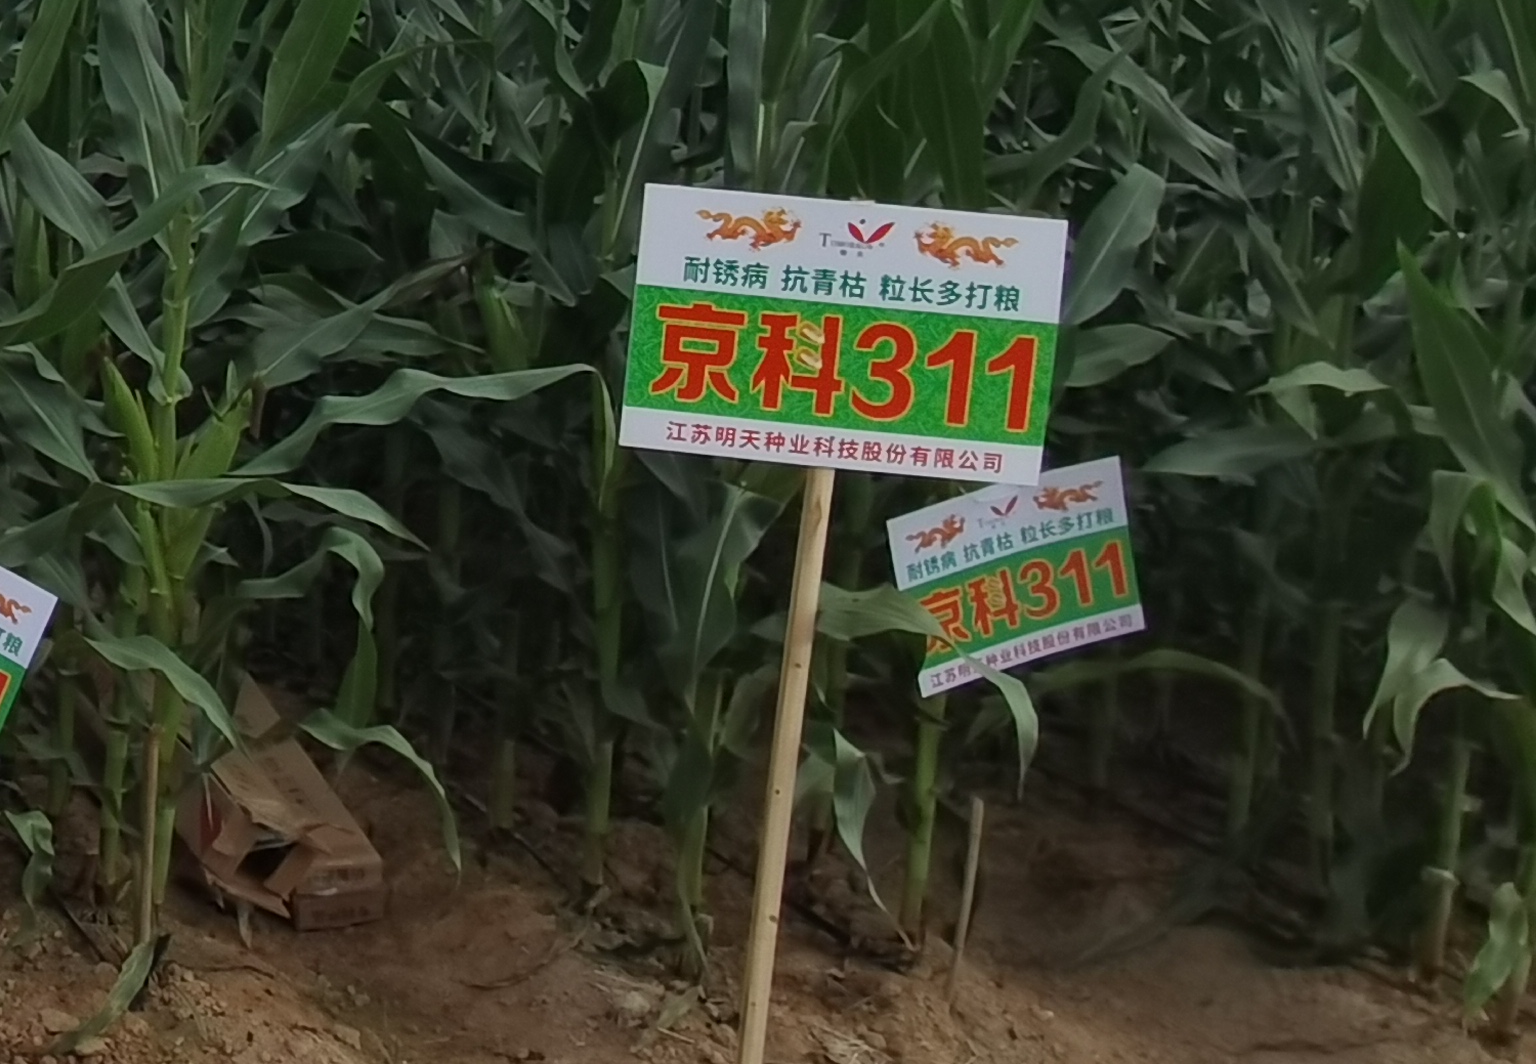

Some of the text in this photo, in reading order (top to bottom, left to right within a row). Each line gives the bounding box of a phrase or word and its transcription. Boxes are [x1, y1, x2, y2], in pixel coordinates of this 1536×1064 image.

[683, 256, 1021, 312] 耐锈病 抗青枯 粒长多打粮
[648, 301, 1039, 434] 京科311
[666, 421, 1004, 473] 江苏明天种业科技股份有限公司
[906, 550, 958, 582] 耐锈病
[963, 533, 1014, 562] 抗青枯
[1020, 508, 1115, 544] 粒长多打粮
[930, 613, 1134, 689] 江苏明种业科技股份有限公司
